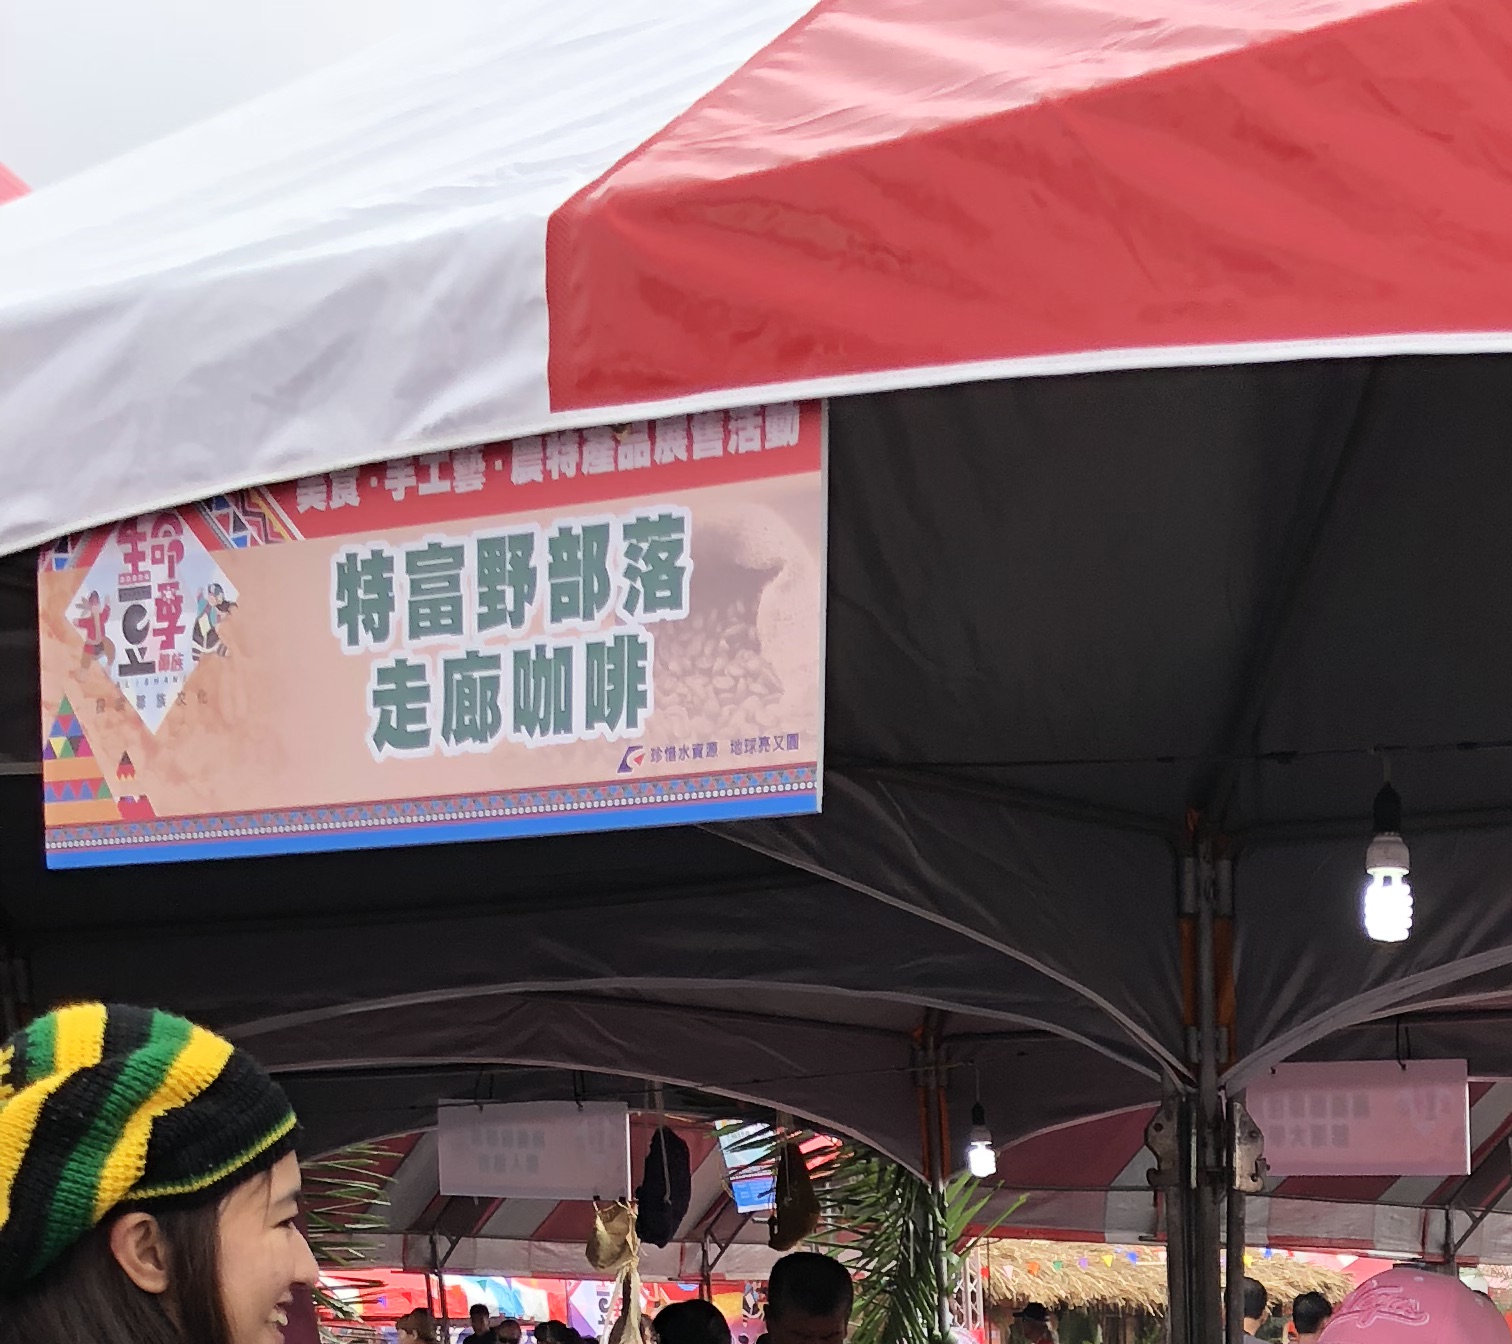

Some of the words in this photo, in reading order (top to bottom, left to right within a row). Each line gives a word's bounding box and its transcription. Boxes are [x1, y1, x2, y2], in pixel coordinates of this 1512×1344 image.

[335, 513, 686, 647] 特富野部落
[372, 634, 650, 752] 走廊咖啡
[650, 741, 718, 763] 珍惜水資源
[730, 733, 799, 755] 地球亮又圓
